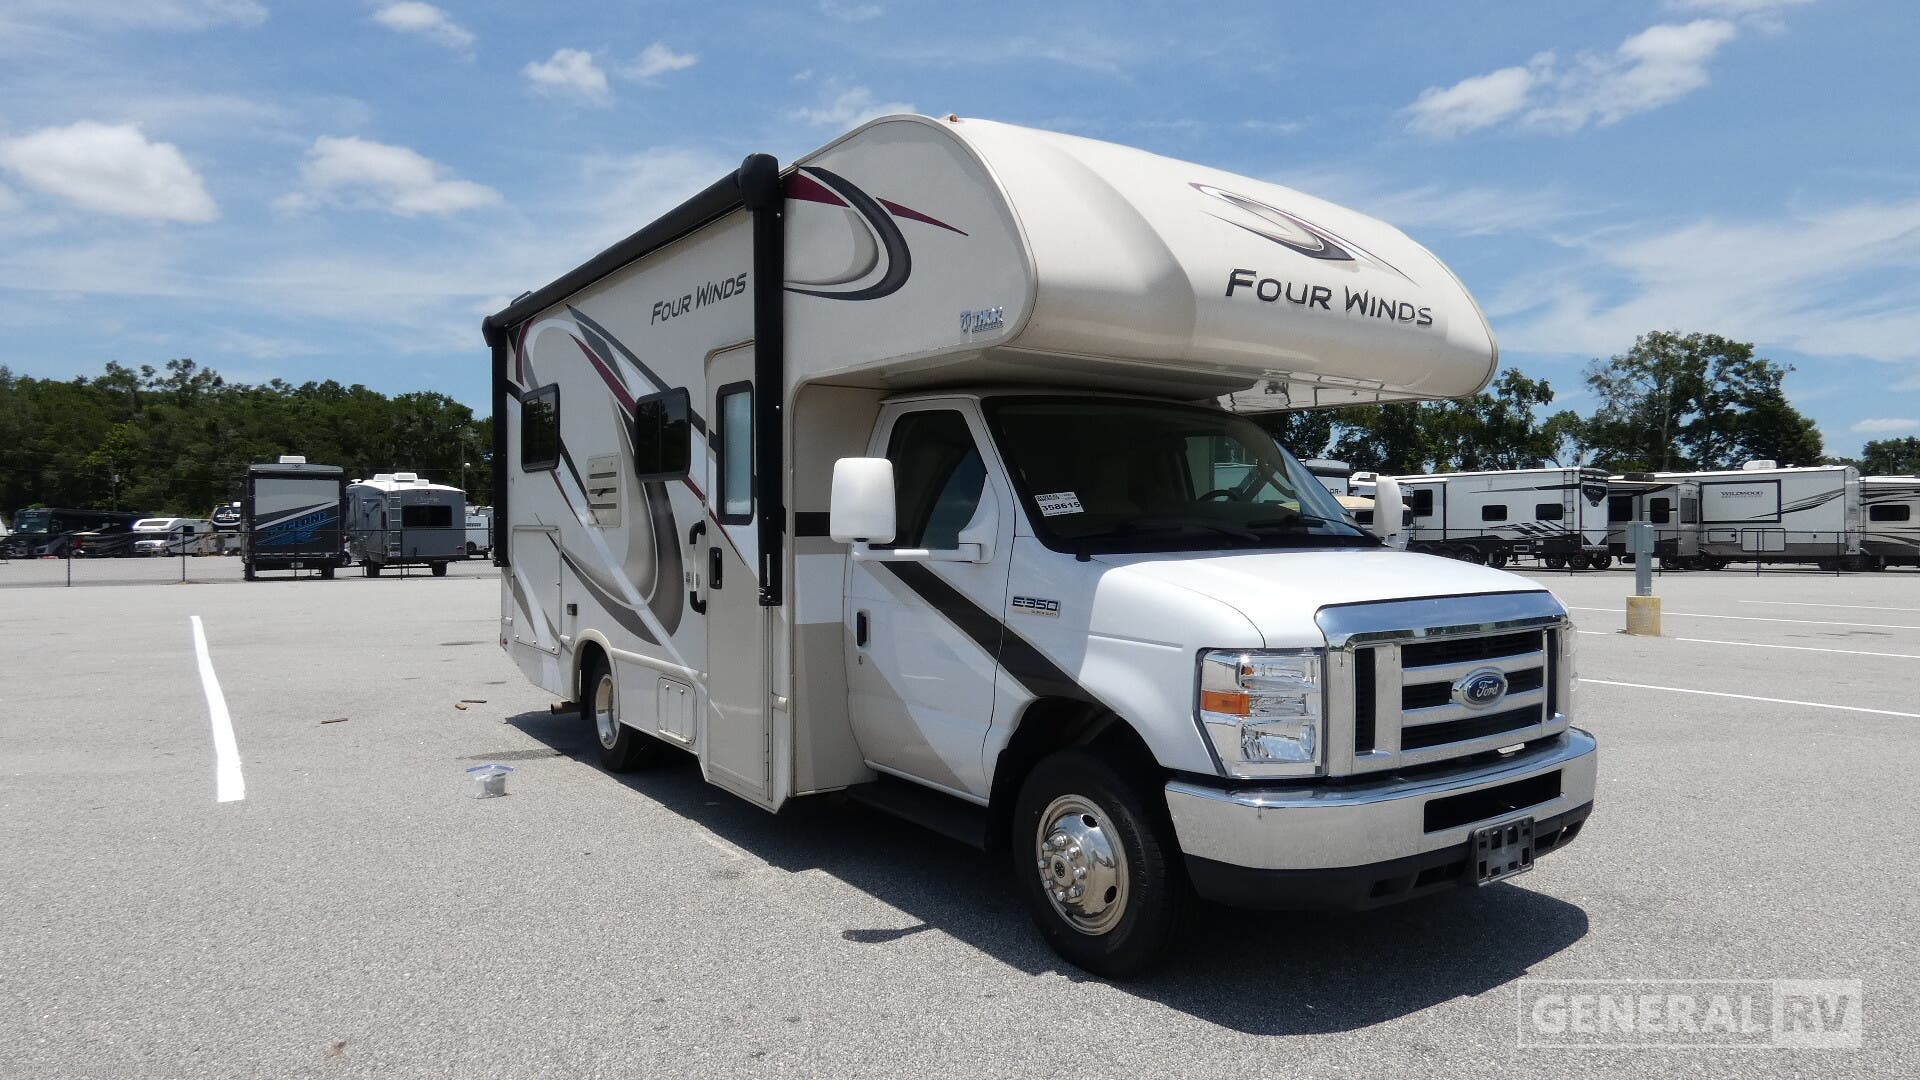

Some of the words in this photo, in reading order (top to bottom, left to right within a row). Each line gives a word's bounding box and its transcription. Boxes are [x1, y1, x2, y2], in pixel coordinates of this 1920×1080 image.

[651, 294, 692, 326] FOUR
[696, 272, 747, 310] WINDS
[1225, 268, 1333, 311] FOUR
[1345, 285, 1433, 325] WINDS
[1041, 501, 1081, 511] 358615
[1476, 680, 1499, 698] Ford
